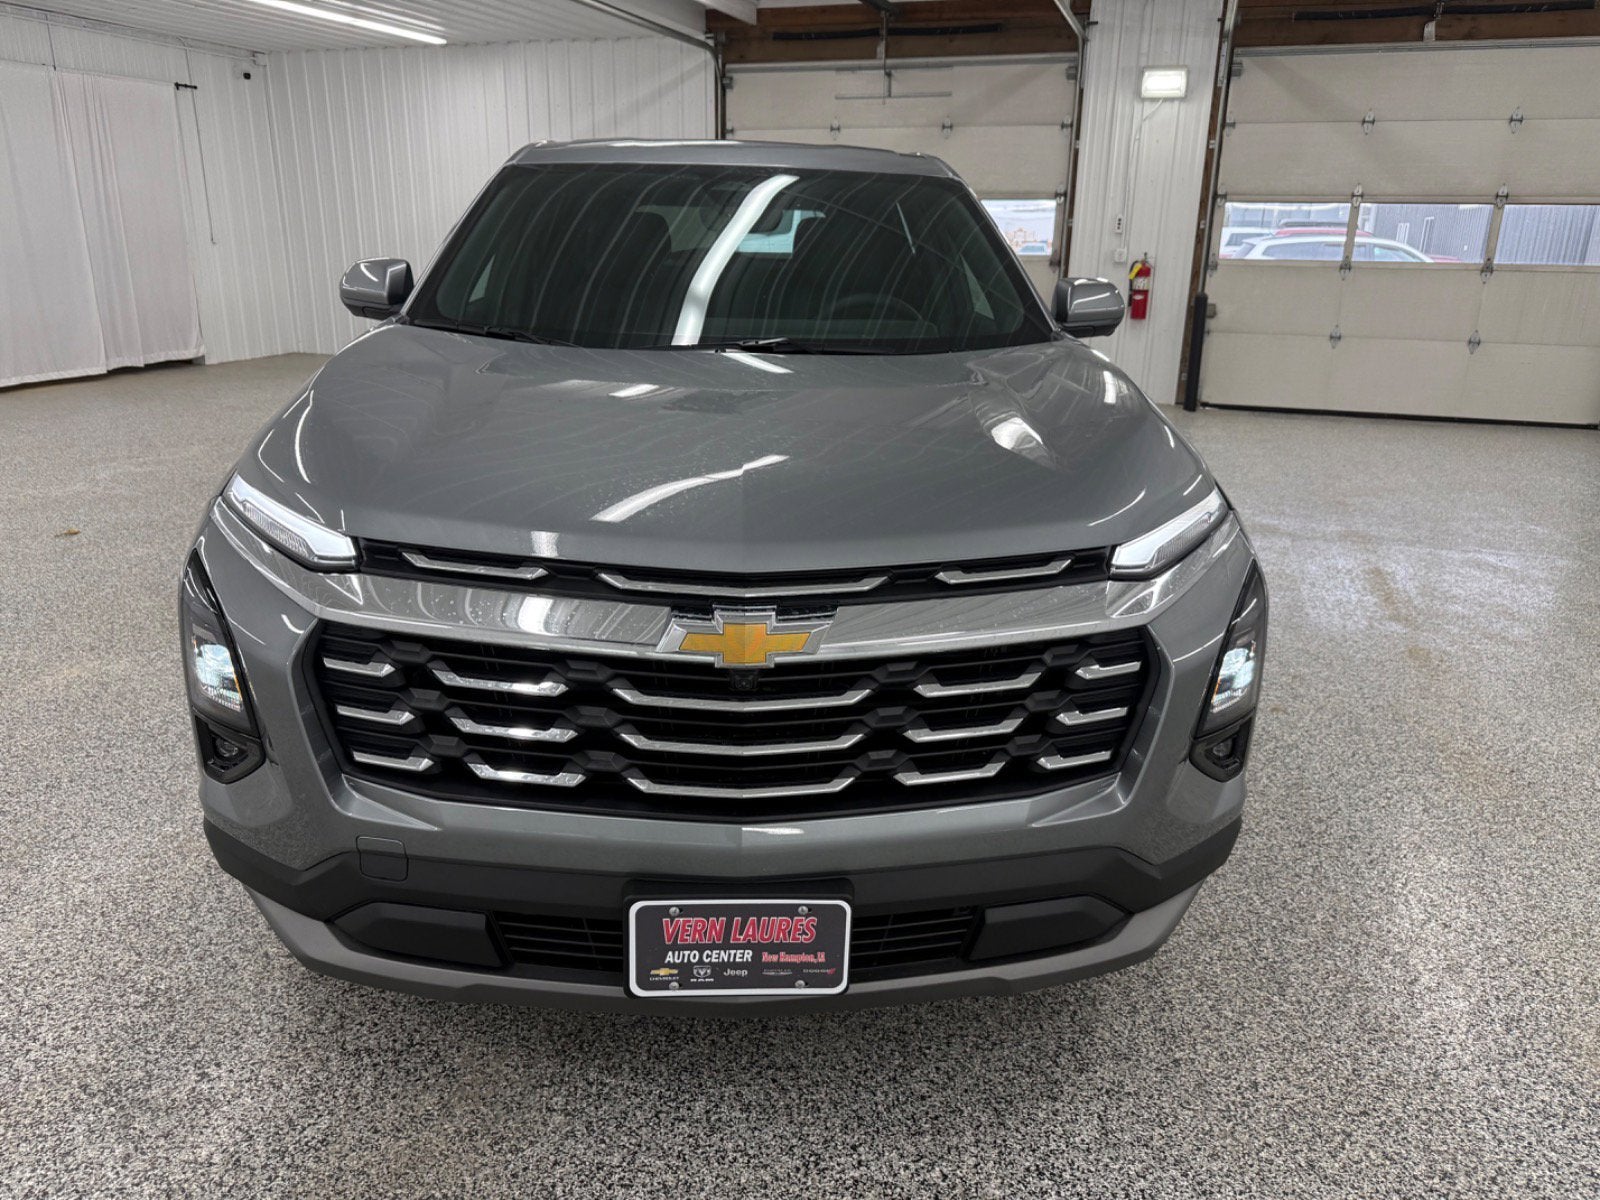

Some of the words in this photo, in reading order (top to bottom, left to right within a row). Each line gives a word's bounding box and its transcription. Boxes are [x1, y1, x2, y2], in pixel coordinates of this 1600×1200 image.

[662, 917, 727, 944] VERN
[730, 917, 817, 943] LAURES
[665, 951, 698, 963] AUTO
[702, 950, 753, 963] CENTER
[762, 952, 778, 962] New
[723, 968, 748, 977] Jeep
